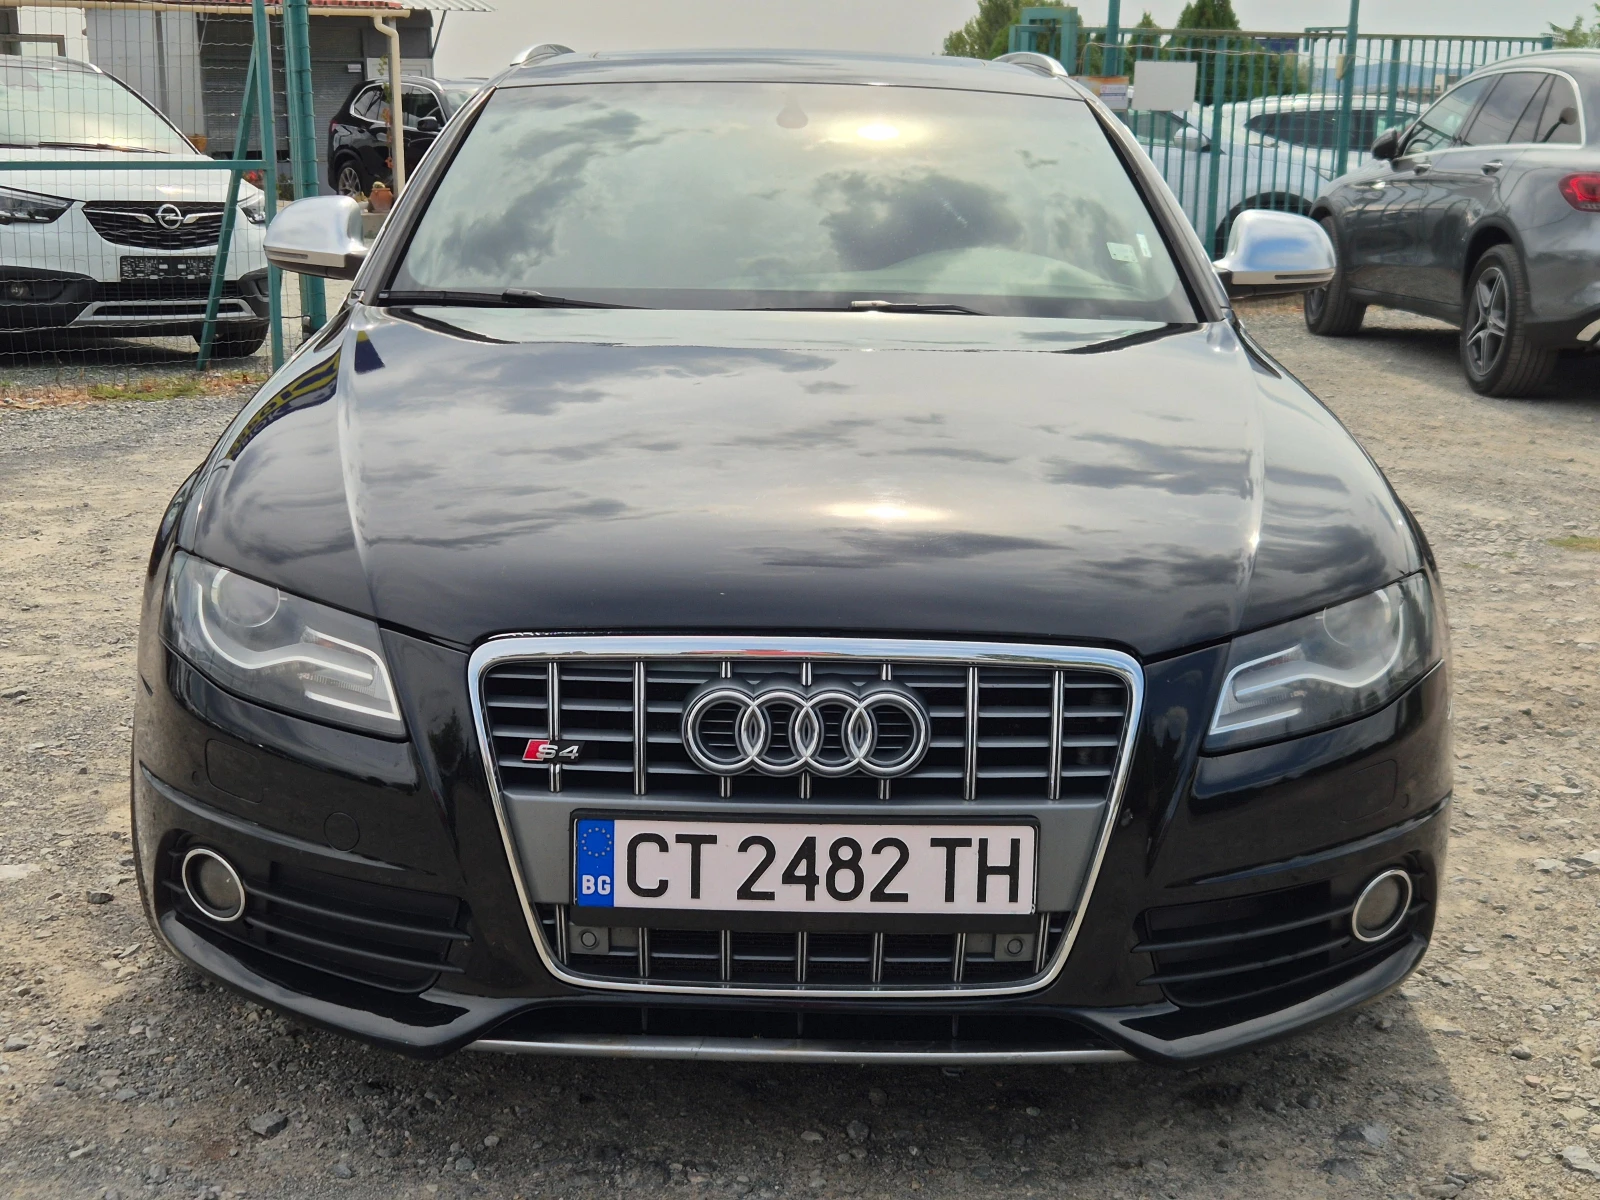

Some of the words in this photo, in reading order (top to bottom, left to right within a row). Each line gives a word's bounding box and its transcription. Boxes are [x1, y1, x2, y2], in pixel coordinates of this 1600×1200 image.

[535, 743, 579, 760] S4
[626, 832, 718, 899] CT
[736, 835, 909, 904] 2482
[930, 837, 1020, 904] TH
[582, 874, 611, 895] BG
